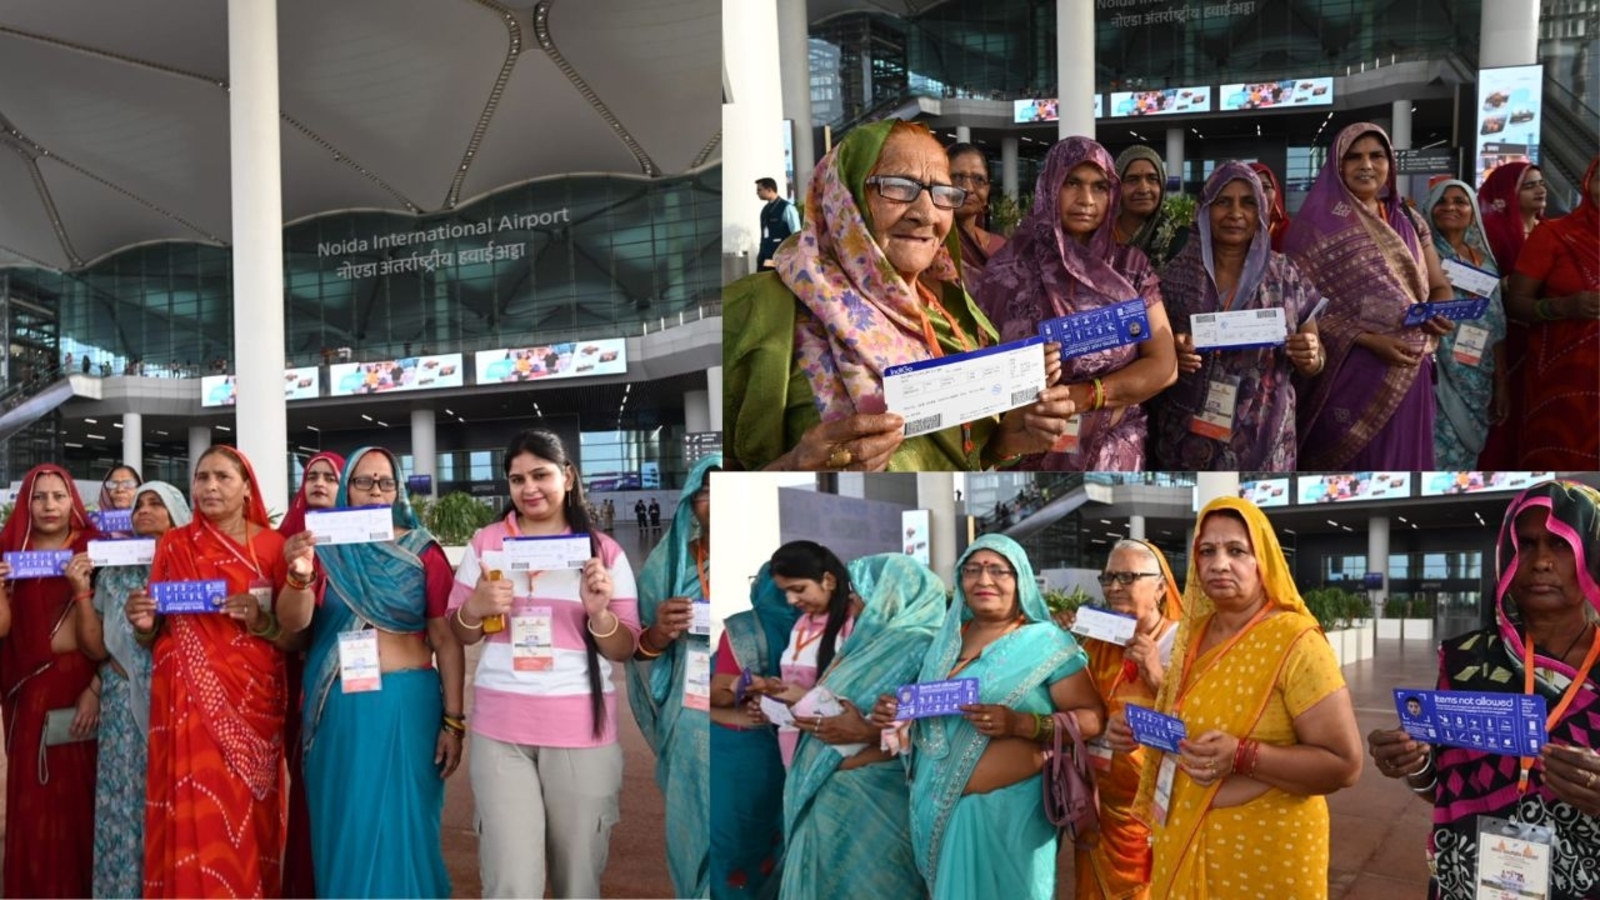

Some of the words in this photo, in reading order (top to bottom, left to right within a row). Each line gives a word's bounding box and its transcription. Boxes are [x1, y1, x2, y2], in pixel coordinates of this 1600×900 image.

[1111, 12, 1142, 28] नोएडा
[1204, 1, 1230, 18] हवाई
[317, 239, 368, 257] Noida
[373, 218, 492, 249] International
[498, 207, 570, 232] Airport
[336, 260, 377, 280] नोएडा
[458, 241, 494, 265] हवाई
[493, 242, 526, 261] अड्डा
[889, 365, 914, 376] IndiGo
[1458, 697, 1475, 706] not
[1475, 695, 1514, 707] allowed
